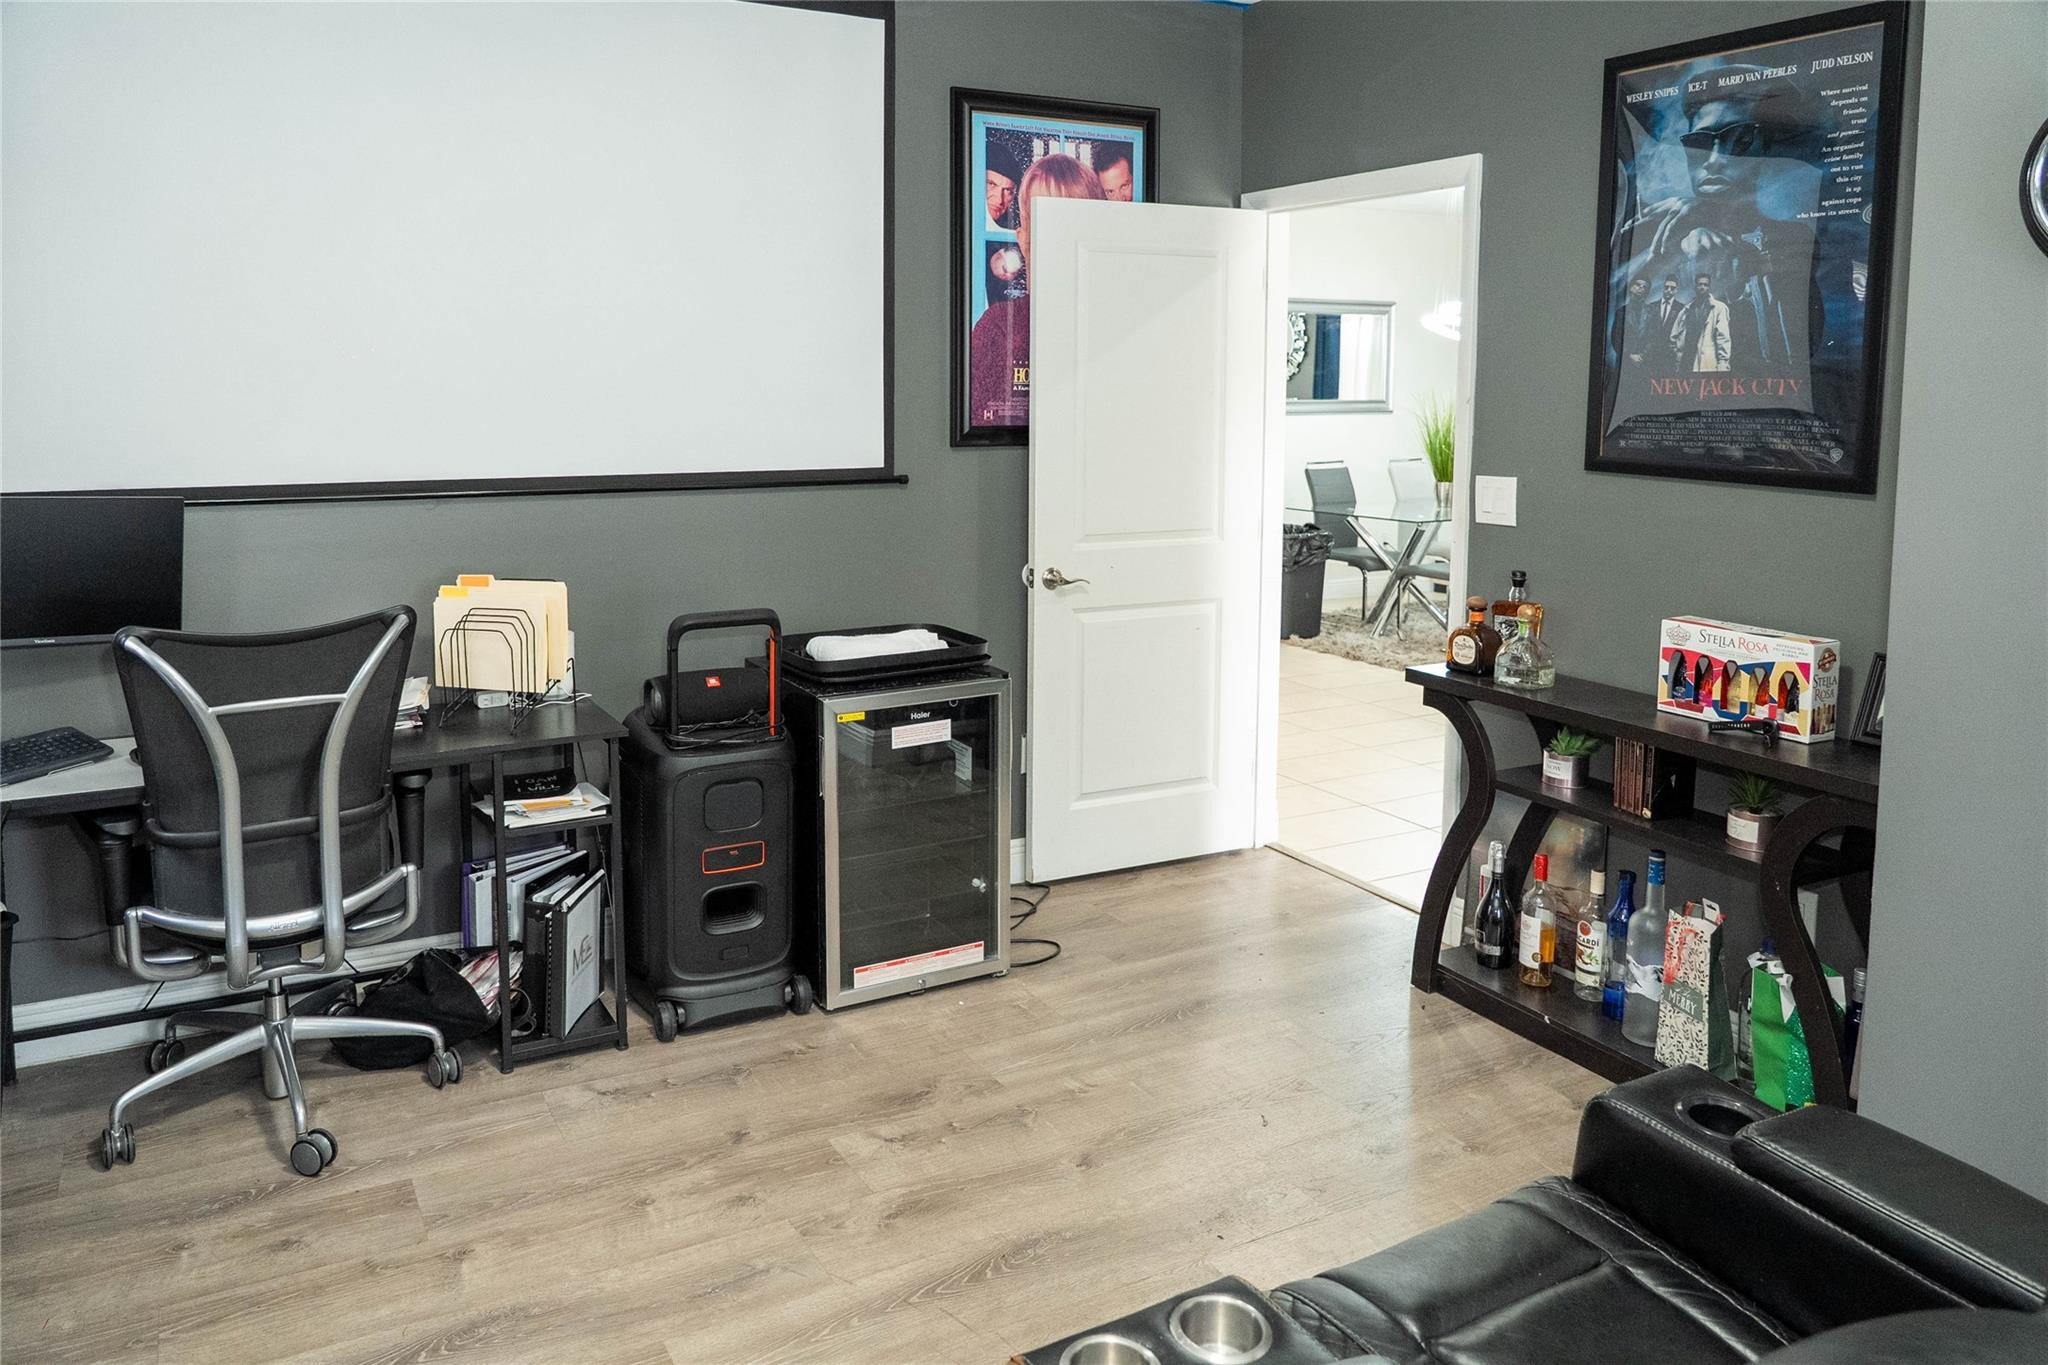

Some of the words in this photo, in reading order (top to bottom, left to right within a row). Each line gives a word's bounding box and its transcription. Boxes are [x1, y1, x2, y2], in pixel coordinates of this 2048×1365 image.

[1626, 90, 1654, 104] WESLEY
[1654, 86, 1679, 99] SNIPES
[1688, 81, 1708, 92] ICE-T
[1718, 74, 1744, 87] MARIO
[1745, 70, 1761, 82] VAN
[1762, 65, 1798, 80] PEEBLES
[1811, 58, 1835, 74] JUDD
[1836, 51, 1874, 67] NELSON
[1830, 97, 1858, 107] depends
[1842, 152, 1864, 160] family
[1821, 198, 1845, 207] against
[1650, 378, 1694, 396] NEW
[1697, 378, 1746, 400] JACK
[1751, 377, 1803, 396] CITY
[1699, 629, 1736, 648] STELLA
[1738, 637, 1768, 654] ROSA
[1813, 674, 1838, 690] STELLA
[1815, 688, 1835, 702] ROSA
[910, 711, 931, 720] Haier
[1668, 988, 1697, 1015] MERRY
